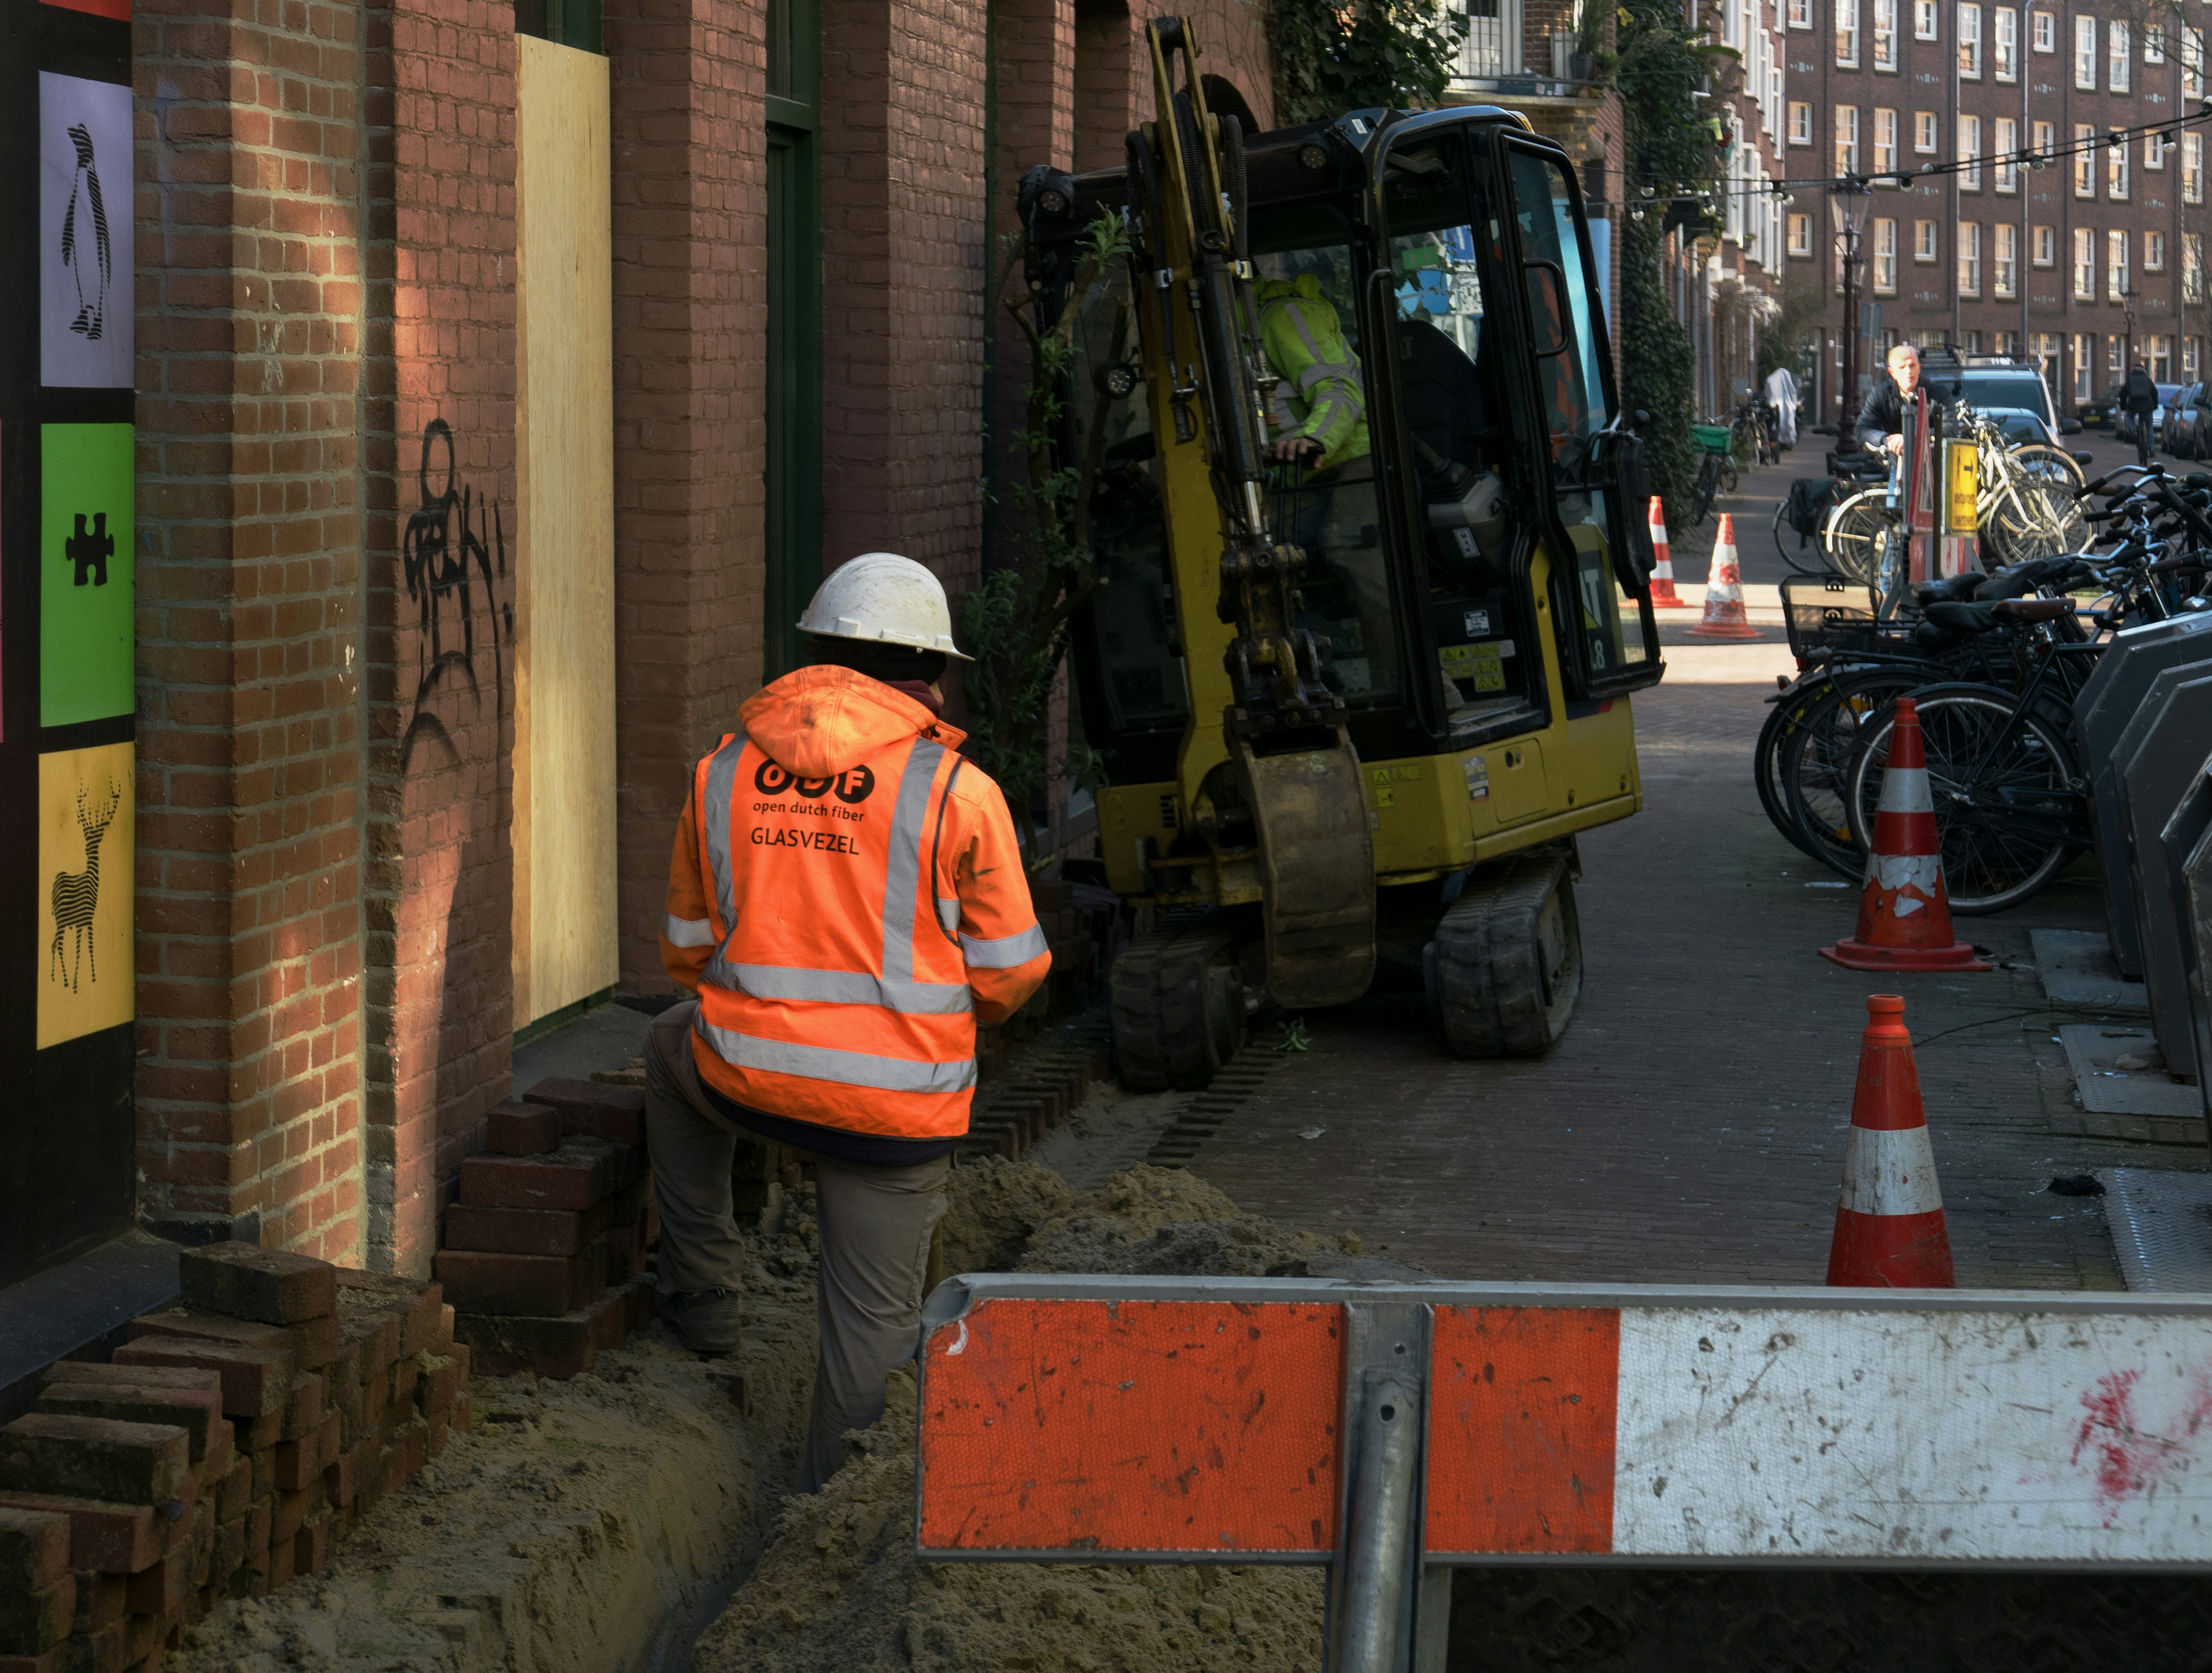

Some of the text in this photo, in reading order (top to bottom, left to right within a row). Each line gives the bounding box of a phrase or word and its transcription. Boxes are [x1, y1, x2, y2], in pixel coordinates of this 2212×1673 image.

[753, 802, 864, 822] open dutch fiber
[751, 827, 860, 855] GLASVEZEL
